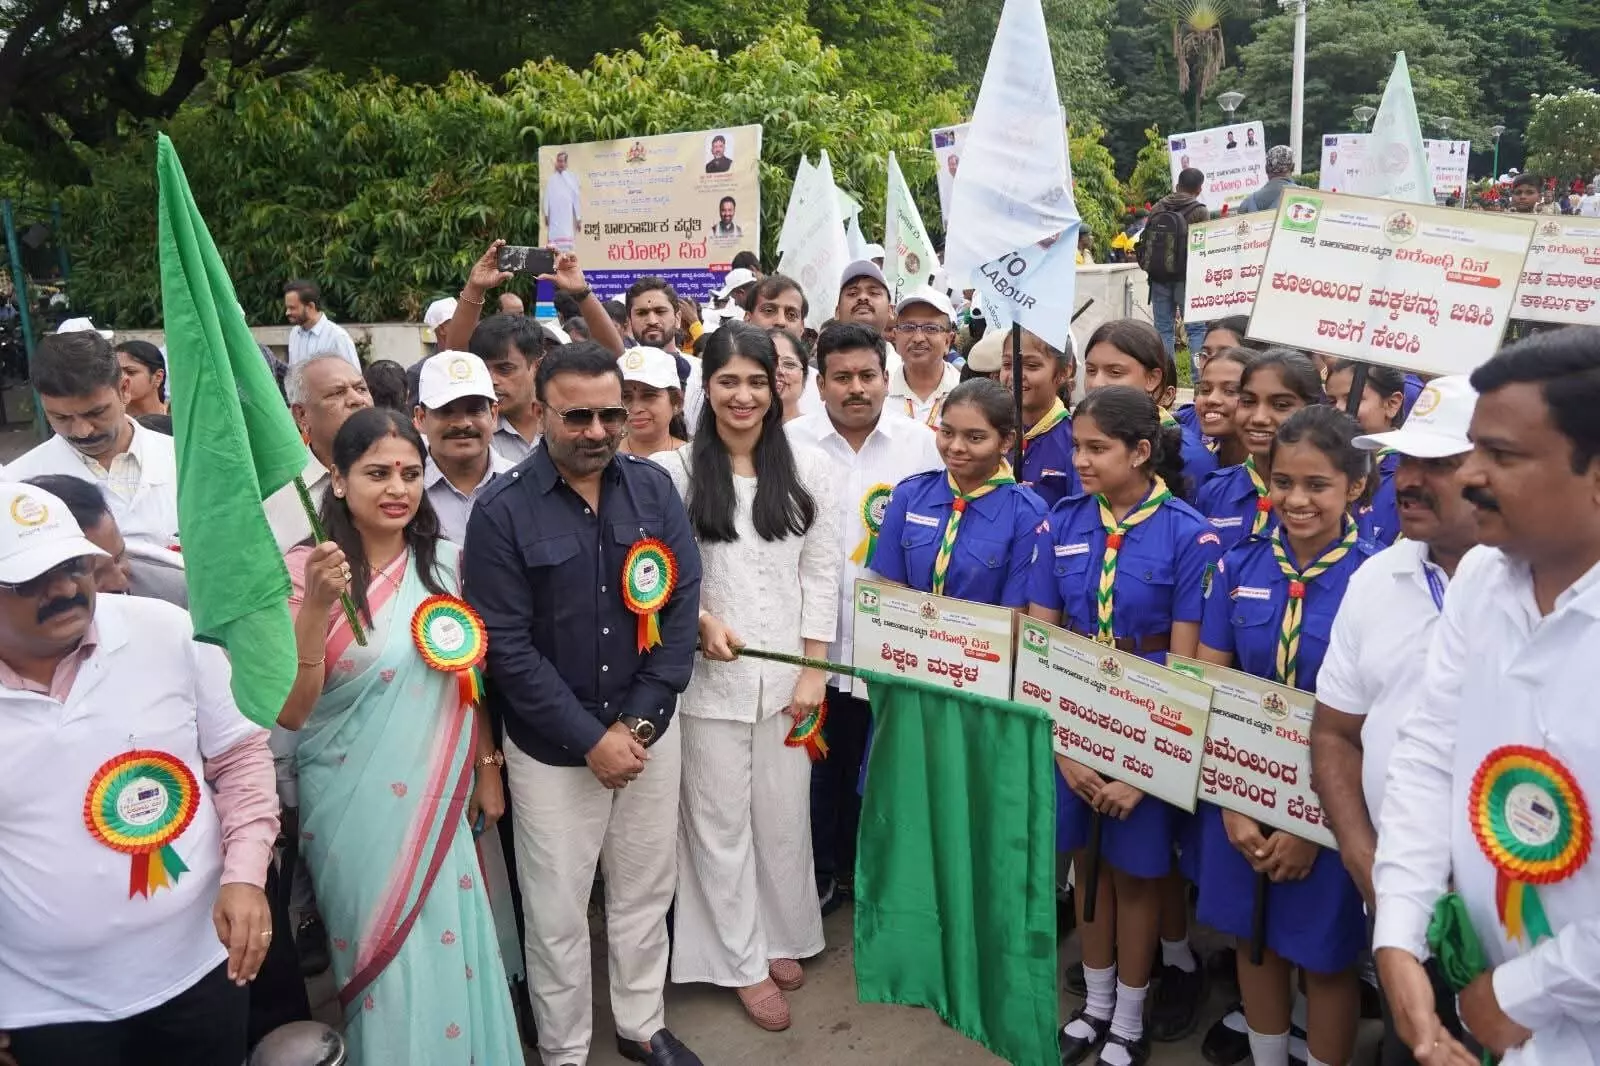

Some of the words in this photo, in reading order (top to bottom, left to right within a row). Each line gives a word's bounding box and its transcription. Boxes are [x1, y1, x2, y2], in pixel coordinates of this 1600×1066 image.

[608, 240, 670, 262] ವಿರೋಧಿ
[679, 236, 707, 259] ದಿನ
[1395, 248, 1454, 271] ವಿರೋಧಿ
[1461, 257, 1489, 273] ದಿನ
[980, 263, 1037, 310] LABOUR
[1271, 271, 1363, 303] ಕೂಲಿಯಿಂದ
[1368, 286, 1440, 327] ಮಕ್ಕಳನ್ನು
[1450, 302, 1494, 327] ಬಿಡಿಸಿ
[1317, 318, 1365, 343] ಶಾಲೆಗೆ
[1370, 323, 1421, 354] ಸೇರಿಸಿ
[929, 629, 968, 648] ವಿರೋಧಿ
[971, 638, 990, 650] ದಿನ
[881, 643, 919, 673] ಶಿಕ್ಷಣ
[927, 657, 979, 688] ಮಕ್ಕಳ
[1022, 681, 1052, 702] ಬಾಲ
[1059, 696, 1147, 744] ಕಾಯಕದಿಂದ
[1109, 686, 1155, 712] ವಿರೋಧಿ
[1161, 705, 1182, 721] ದಿನ
[1123, 754, 1153, 778] ಸುಖ
[1202, 766, 1277, 808] ತ್ತಲಿನಿಂದ
